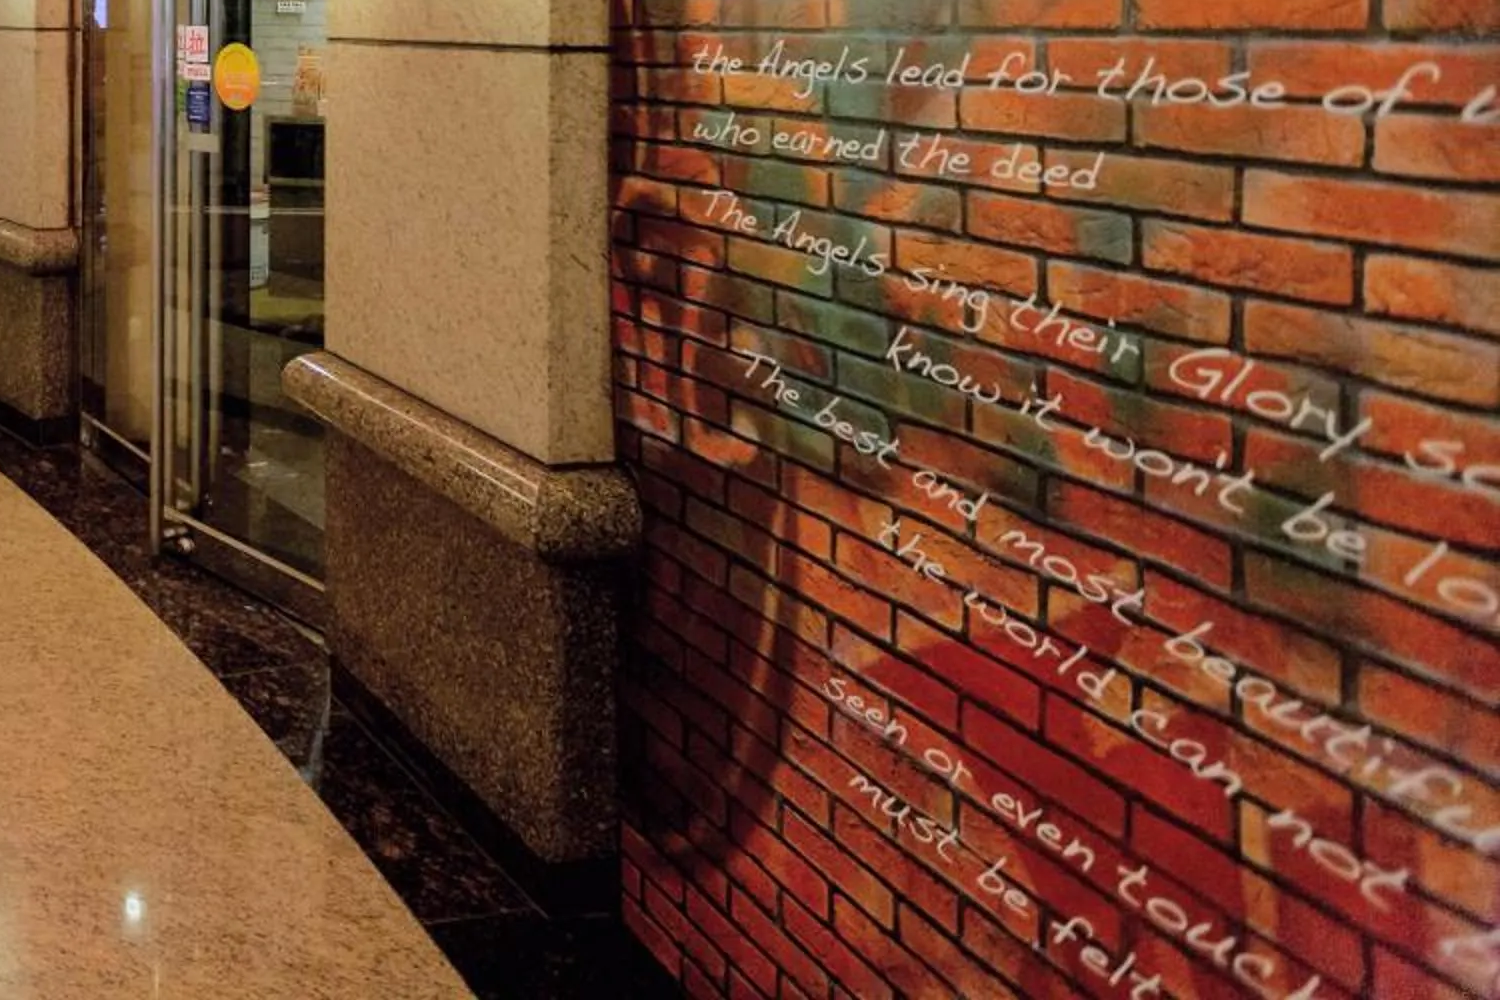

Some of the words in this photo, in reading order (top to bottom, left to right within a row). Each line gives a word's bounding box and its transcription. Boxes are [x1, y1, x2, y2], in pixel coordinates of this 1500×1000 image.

[693, 43, 744, 76] the
[758, 40, 869, 99] Angels
[886, 47, 968, 89] lead
[987, 52, 1072, 95] for
[1098, 57, 1286, 108] those
[1322, 61, 1442, 119] of
[693, 112, 760, 148] who
[773, 122, 883, 162] earned
[900, 132, 971, 175] the
[991, 143, 1104, 191] deed
[701, 191, 757, 233] The
[773, 211, 886, 277] Angels
[903, 264, 991, 333] sing
[1010, 292, 1140, 363] their
[1169, 349, 1372, 463] Glory
[737, 349, 800, 407] The
[811, 397, 900, 469] best
[913, 470, 990, 521] and
[1001, 528, 1146, 626] most
[1018, 382, 1065, 431] it
[1082, 428, 1256, 514] won't
[1281, 490, 1367, 557] be
[878, 518, 946, 584] the
[962, 590, 1116, 702] world
[1131, 708, 1242, 796] can
[1268, 808, 1408, 912] not
[924, 747, 973, 784] or
[992, 791, 1097, 872] even
[850, 773, 960, 864] must
[977, 856, 1030, 916] be
[1053, 915, 1162, 1000] felt
